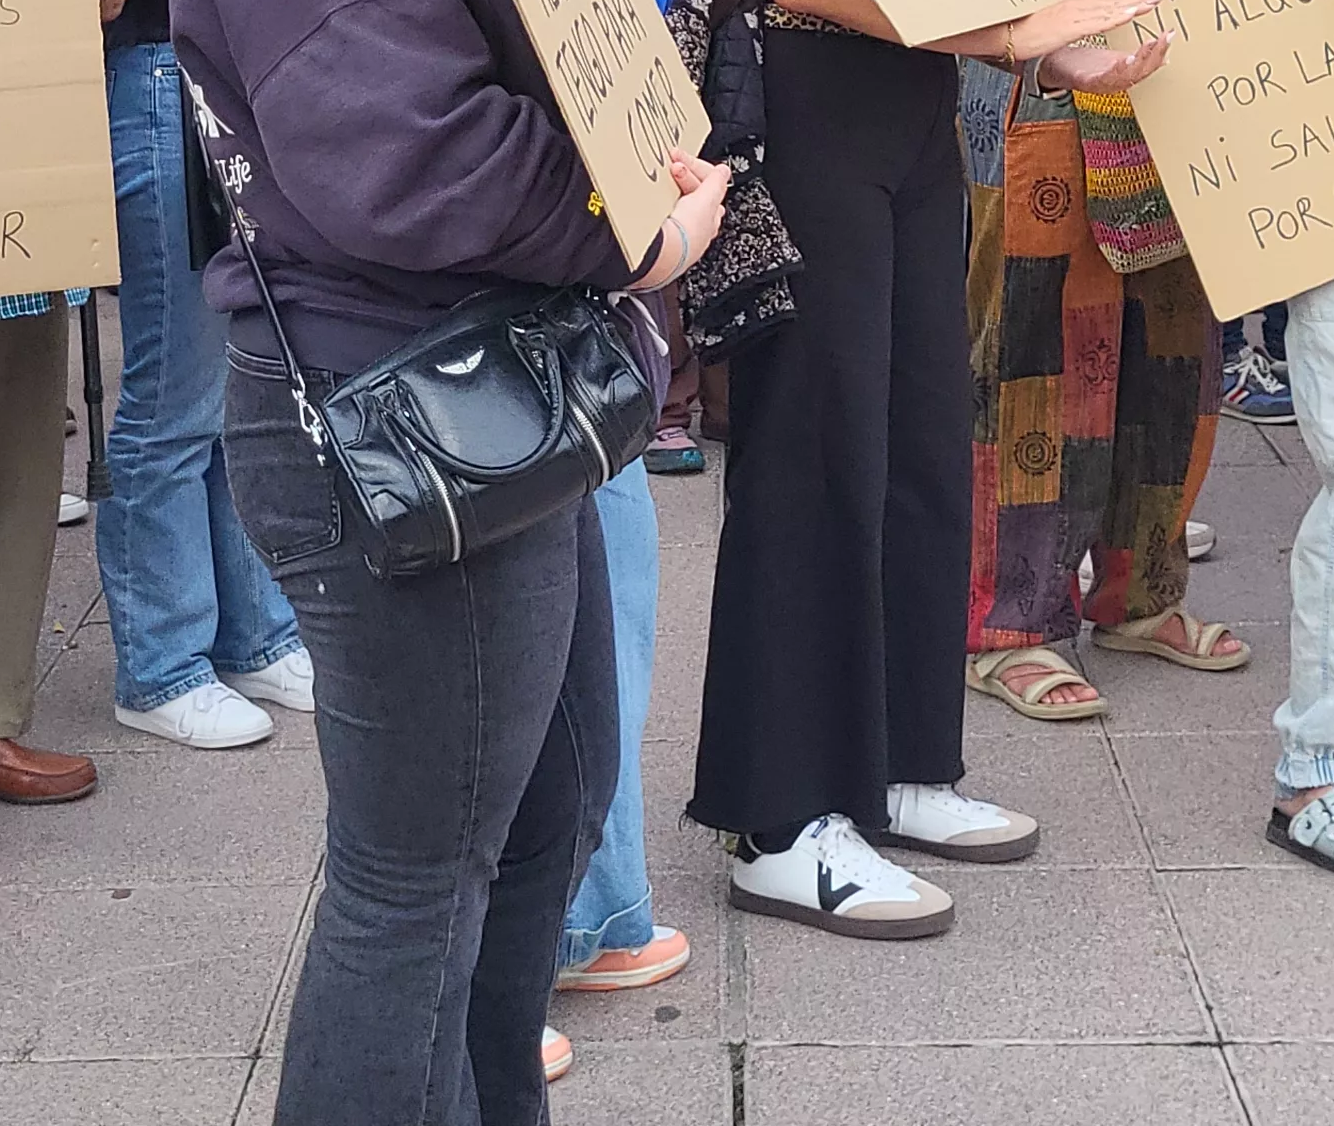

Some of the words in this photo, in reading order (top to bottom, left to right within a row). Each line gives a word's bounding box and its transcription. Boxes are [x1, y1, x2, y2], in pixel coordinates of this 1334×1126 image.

[555, 11, 615, 136] TENGO
[1205, 61, 1289, 113] POR
[626, 55, 689, 184] COMER
[1246, 195, 1334, 250] POR
